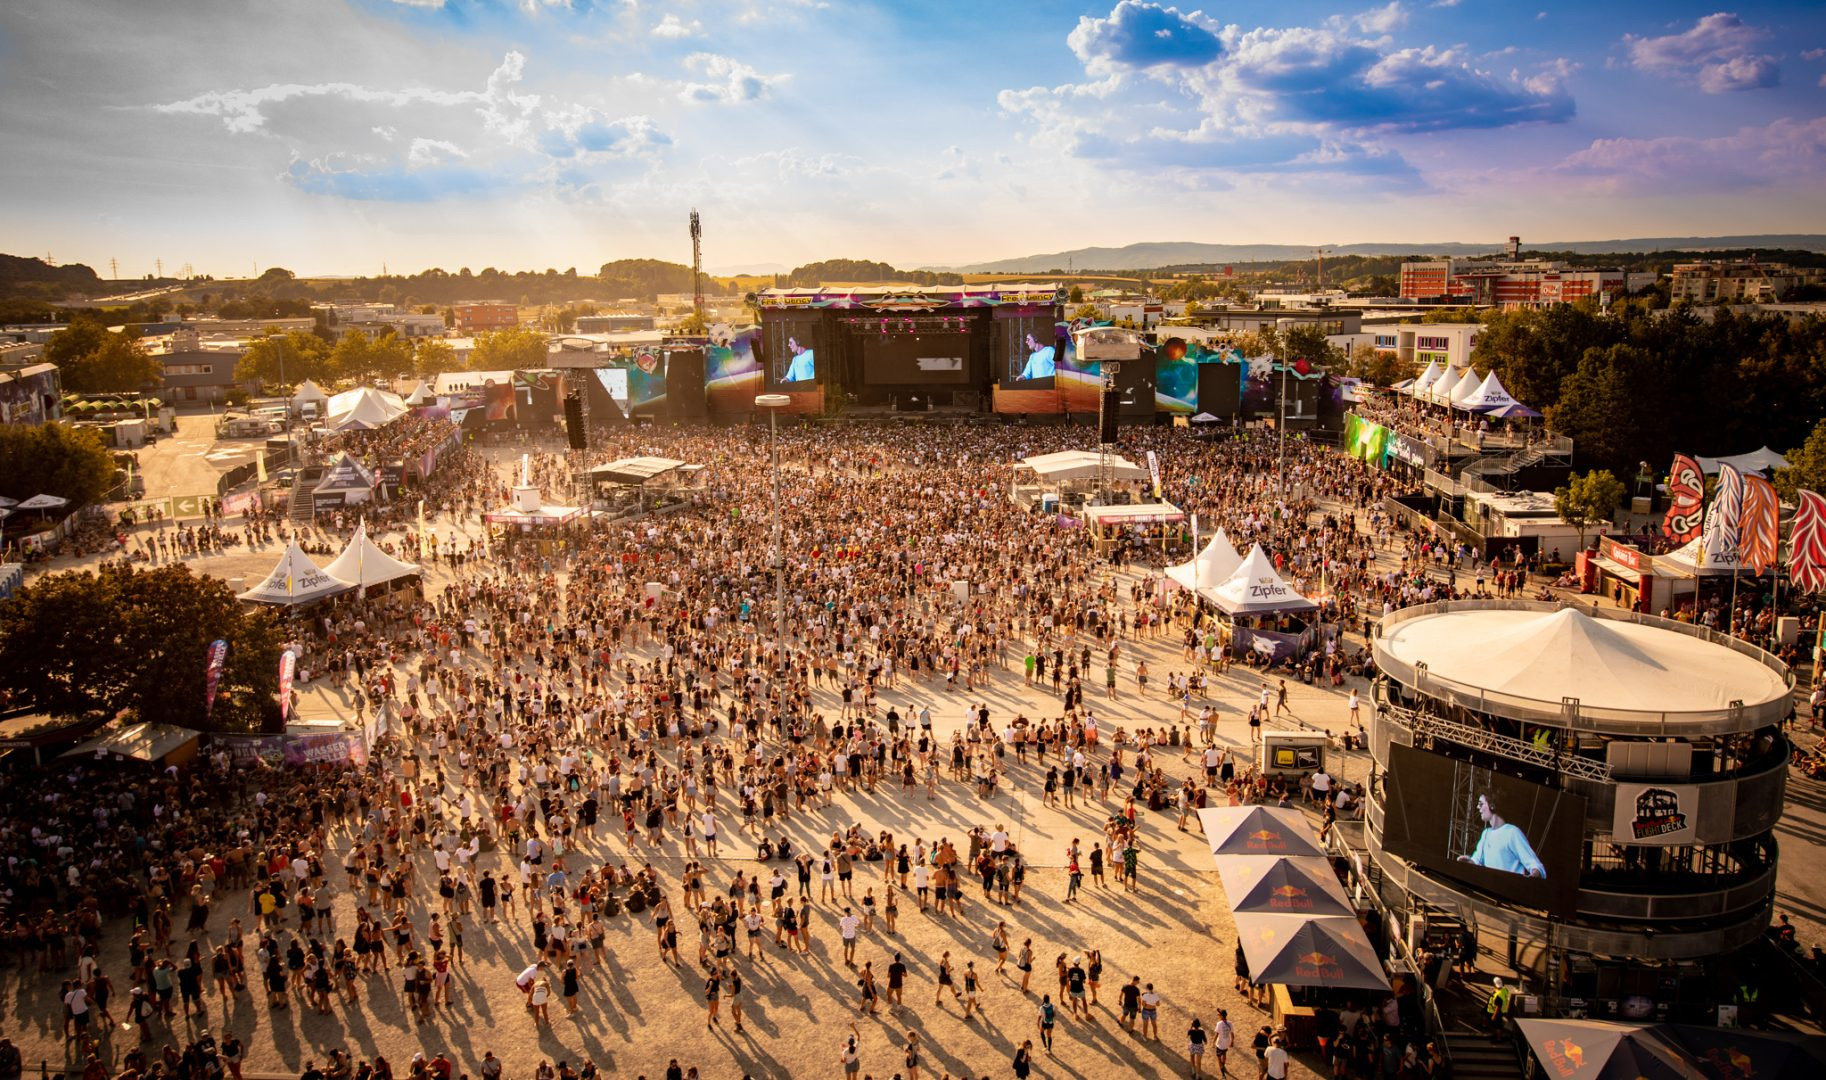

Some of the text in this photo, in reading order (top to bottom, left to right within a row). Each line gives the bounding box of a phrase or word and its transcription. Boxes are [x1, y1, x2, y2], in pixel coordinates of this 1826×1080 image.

[1484, 395, 1509, 403] Zipfer
[298, 575, 330, 588] Zipfer
[1250, 585, 1287, 599] Zipfer
[303, 741, 345, 757] WASSER
[1637, 820, 1682, 837] FLIGHT DECK
